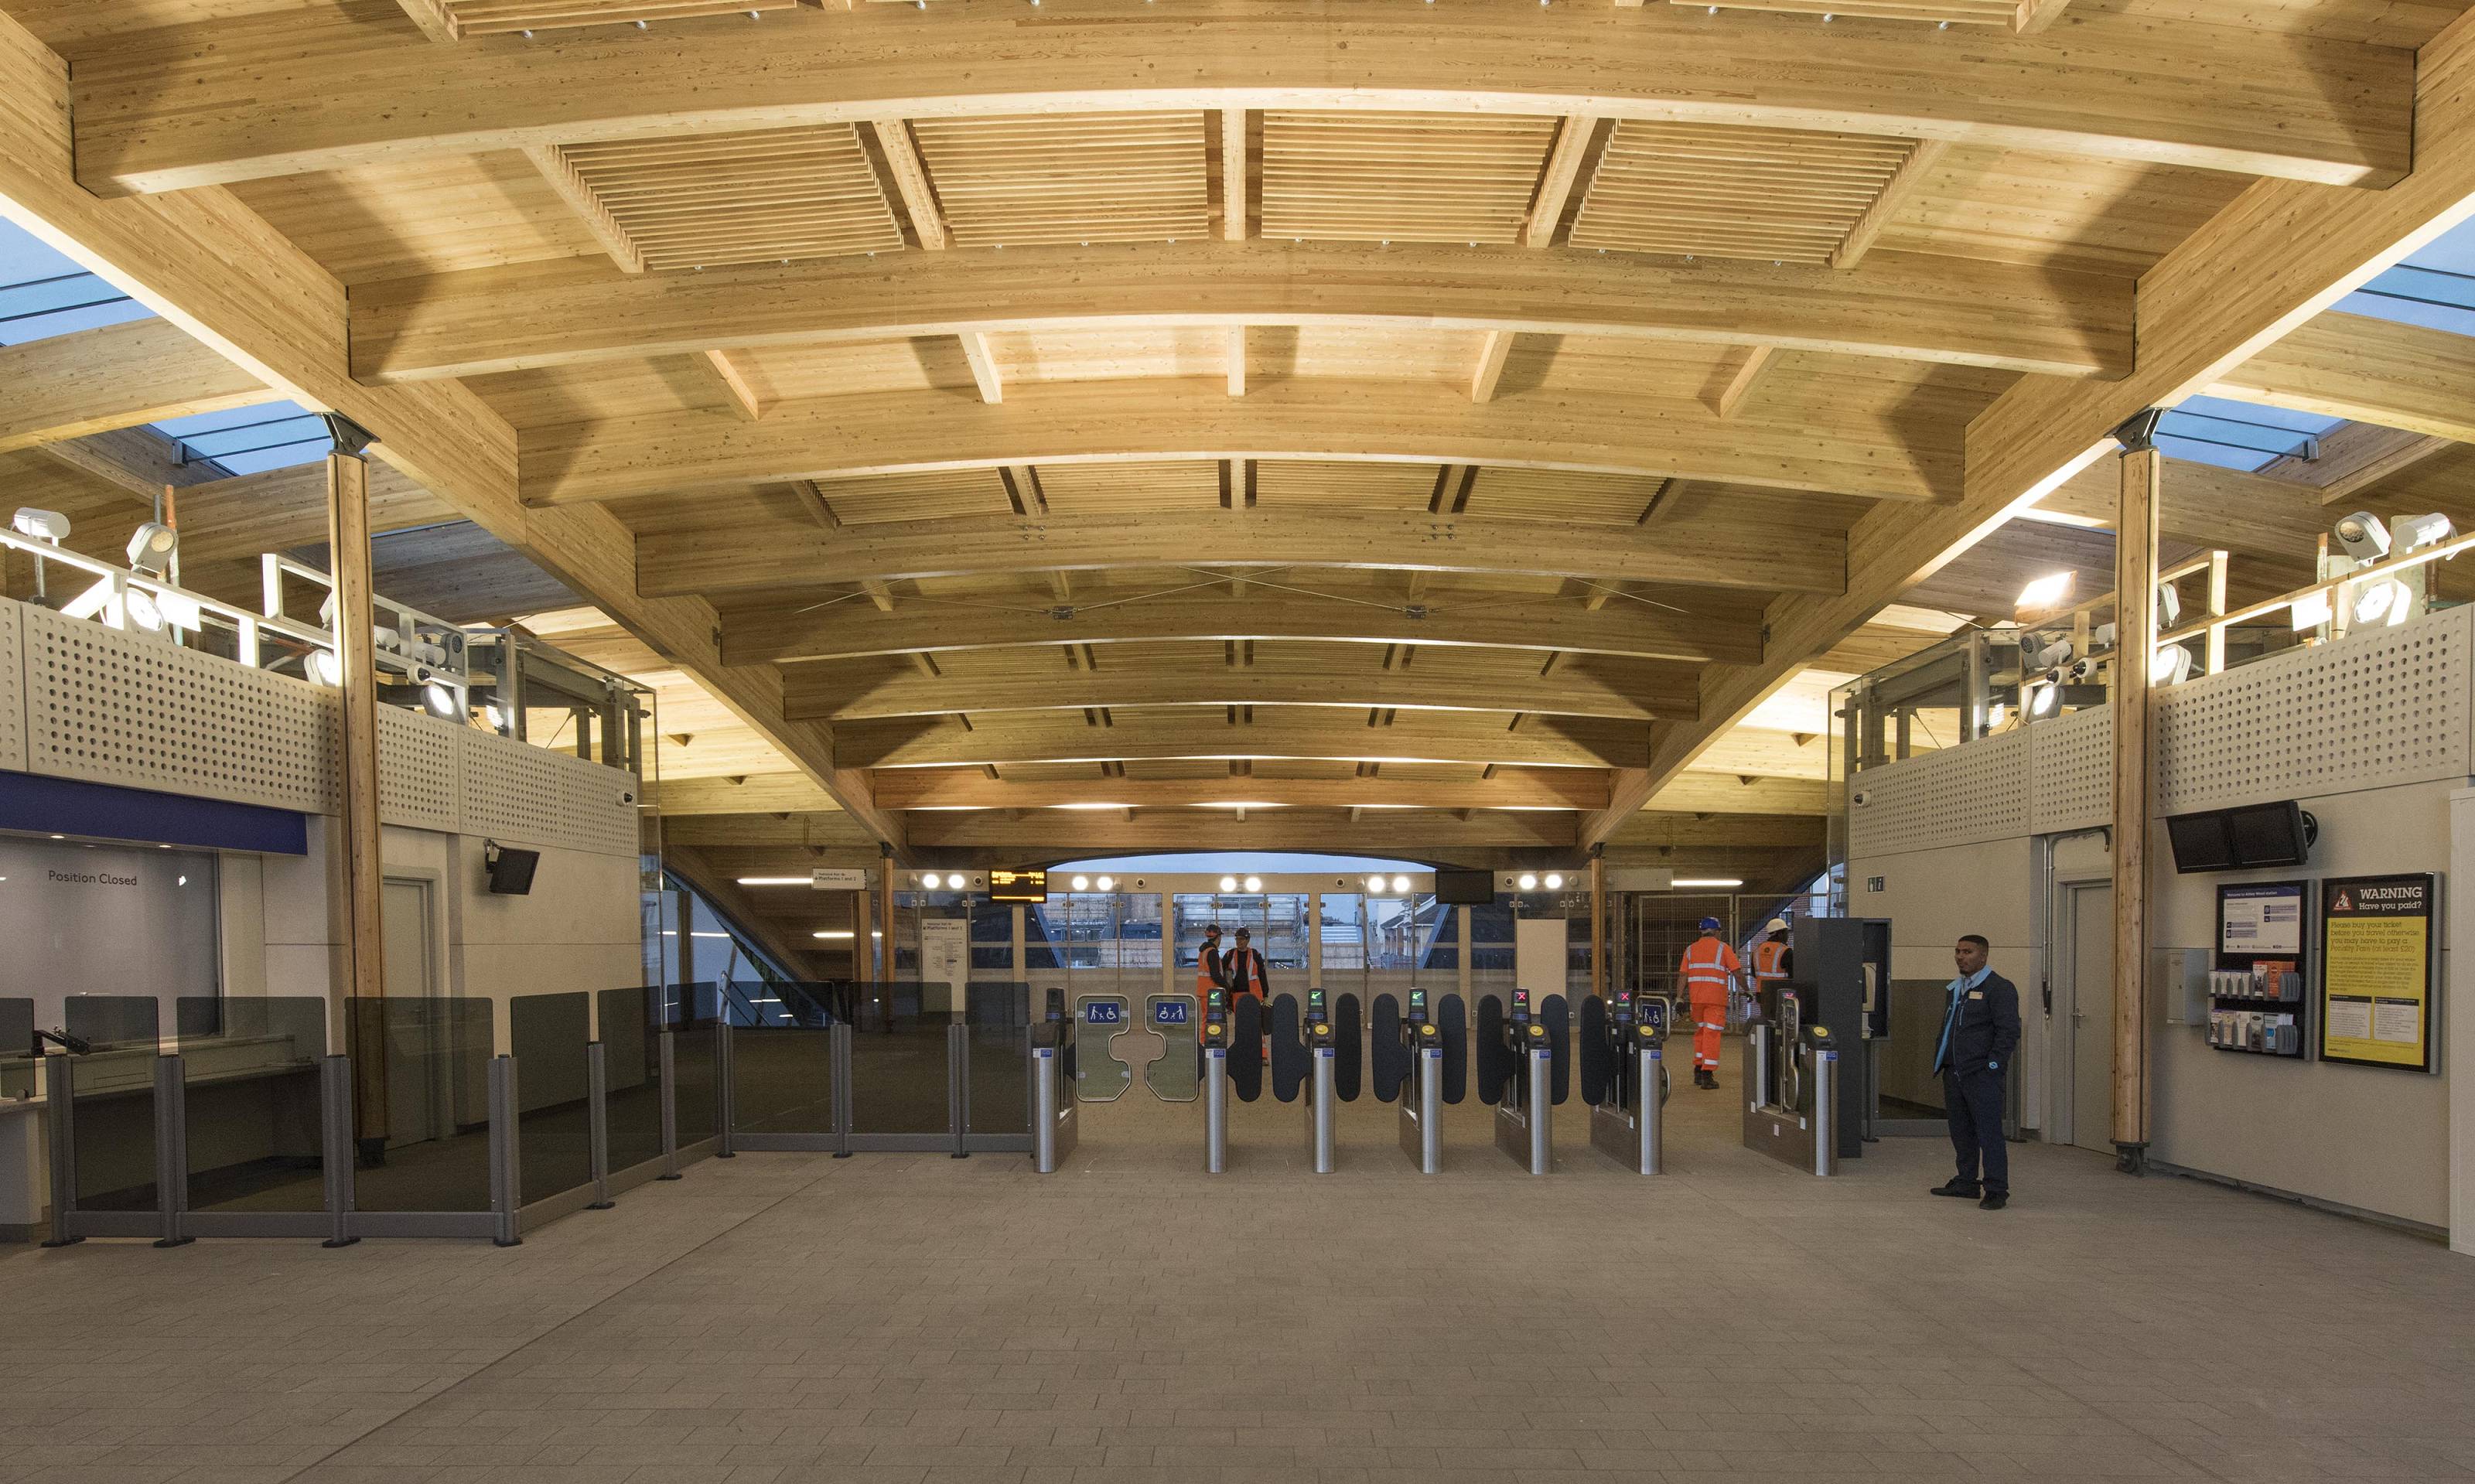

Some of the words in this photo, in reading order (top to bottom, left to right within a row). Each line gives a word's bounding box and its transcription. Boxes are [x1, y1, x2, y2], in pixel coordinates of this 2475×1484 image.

[49, 870, 96, 883] Position
[99, 874, 137, 885] Closed
[2360, 886, 2422, 899] WARNING
[2381, 902, 2396, 911] you
[2398, 901, 2422, 911] paid?
